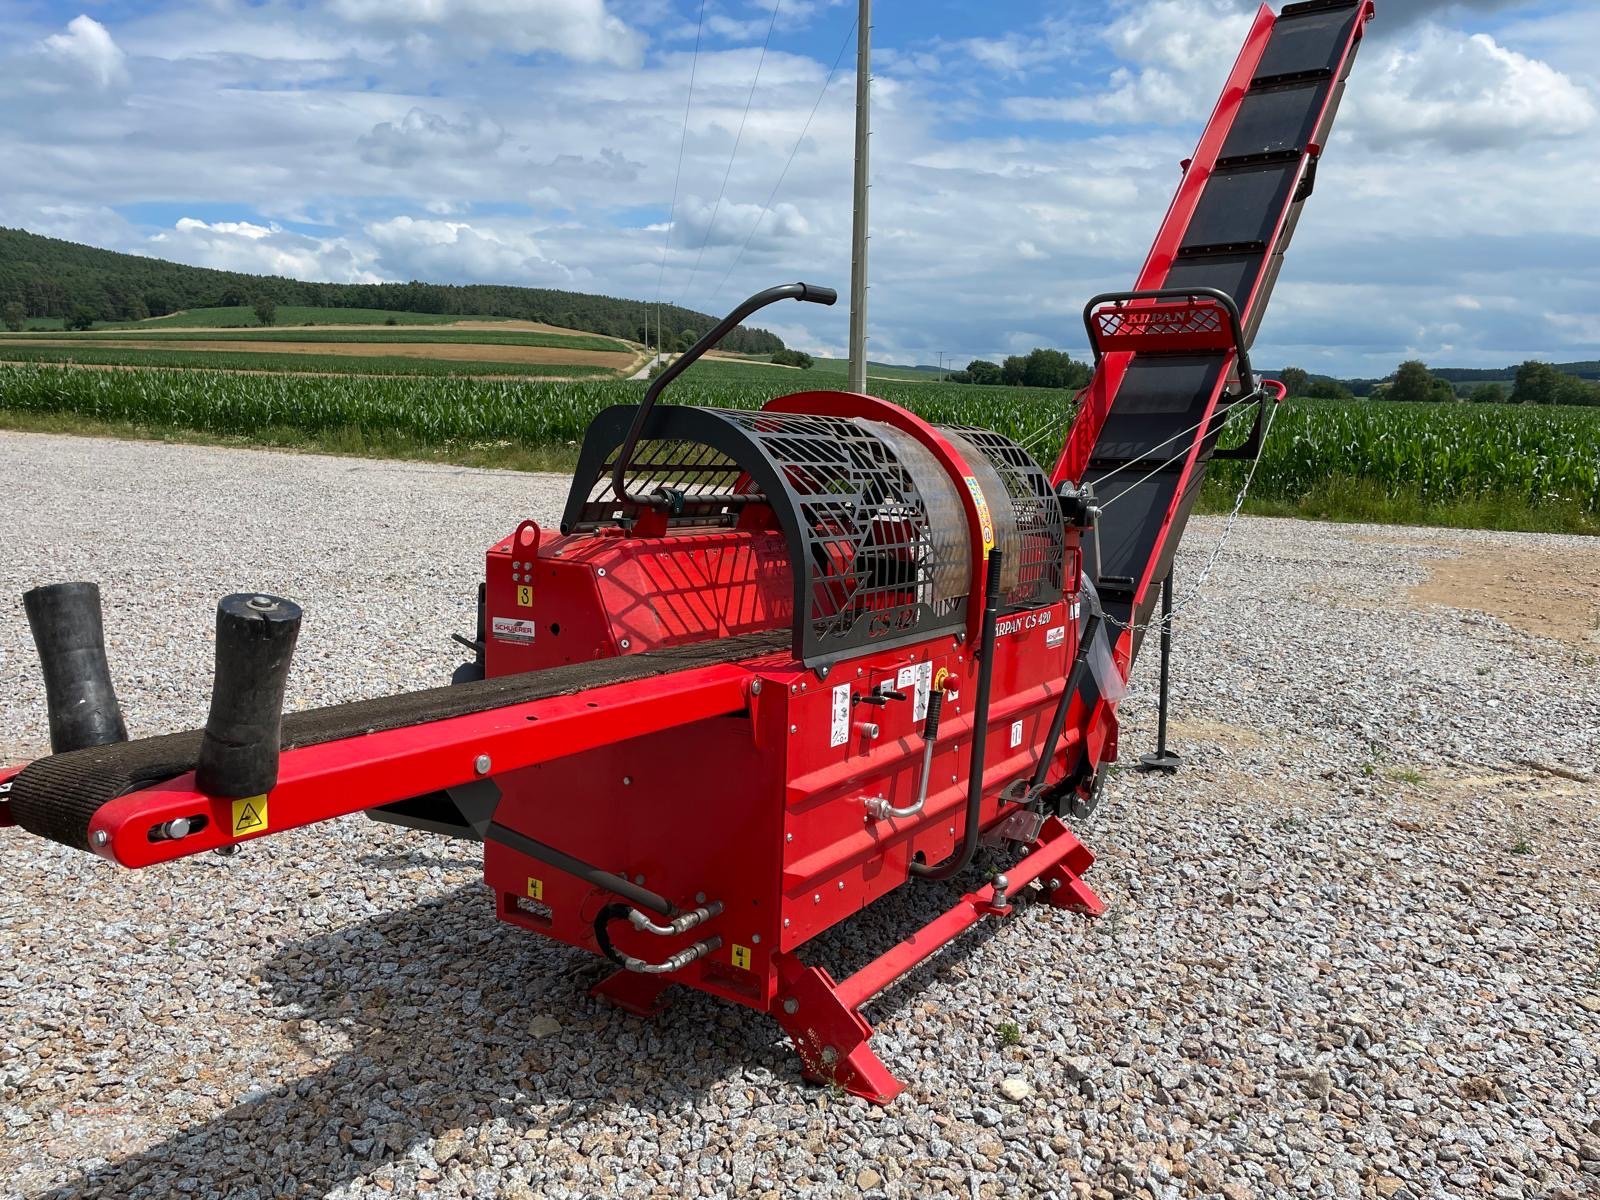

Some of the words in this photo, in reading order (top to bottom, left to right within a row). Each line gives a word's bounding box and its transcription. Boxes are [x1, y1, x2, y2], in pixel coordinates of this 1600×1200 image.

[869, 612, 891, 638] CS
[895, 607, 921, 632] 420
[1025, 614, 1037, 628] CS
[1037, 611, 1051, 625] 420
